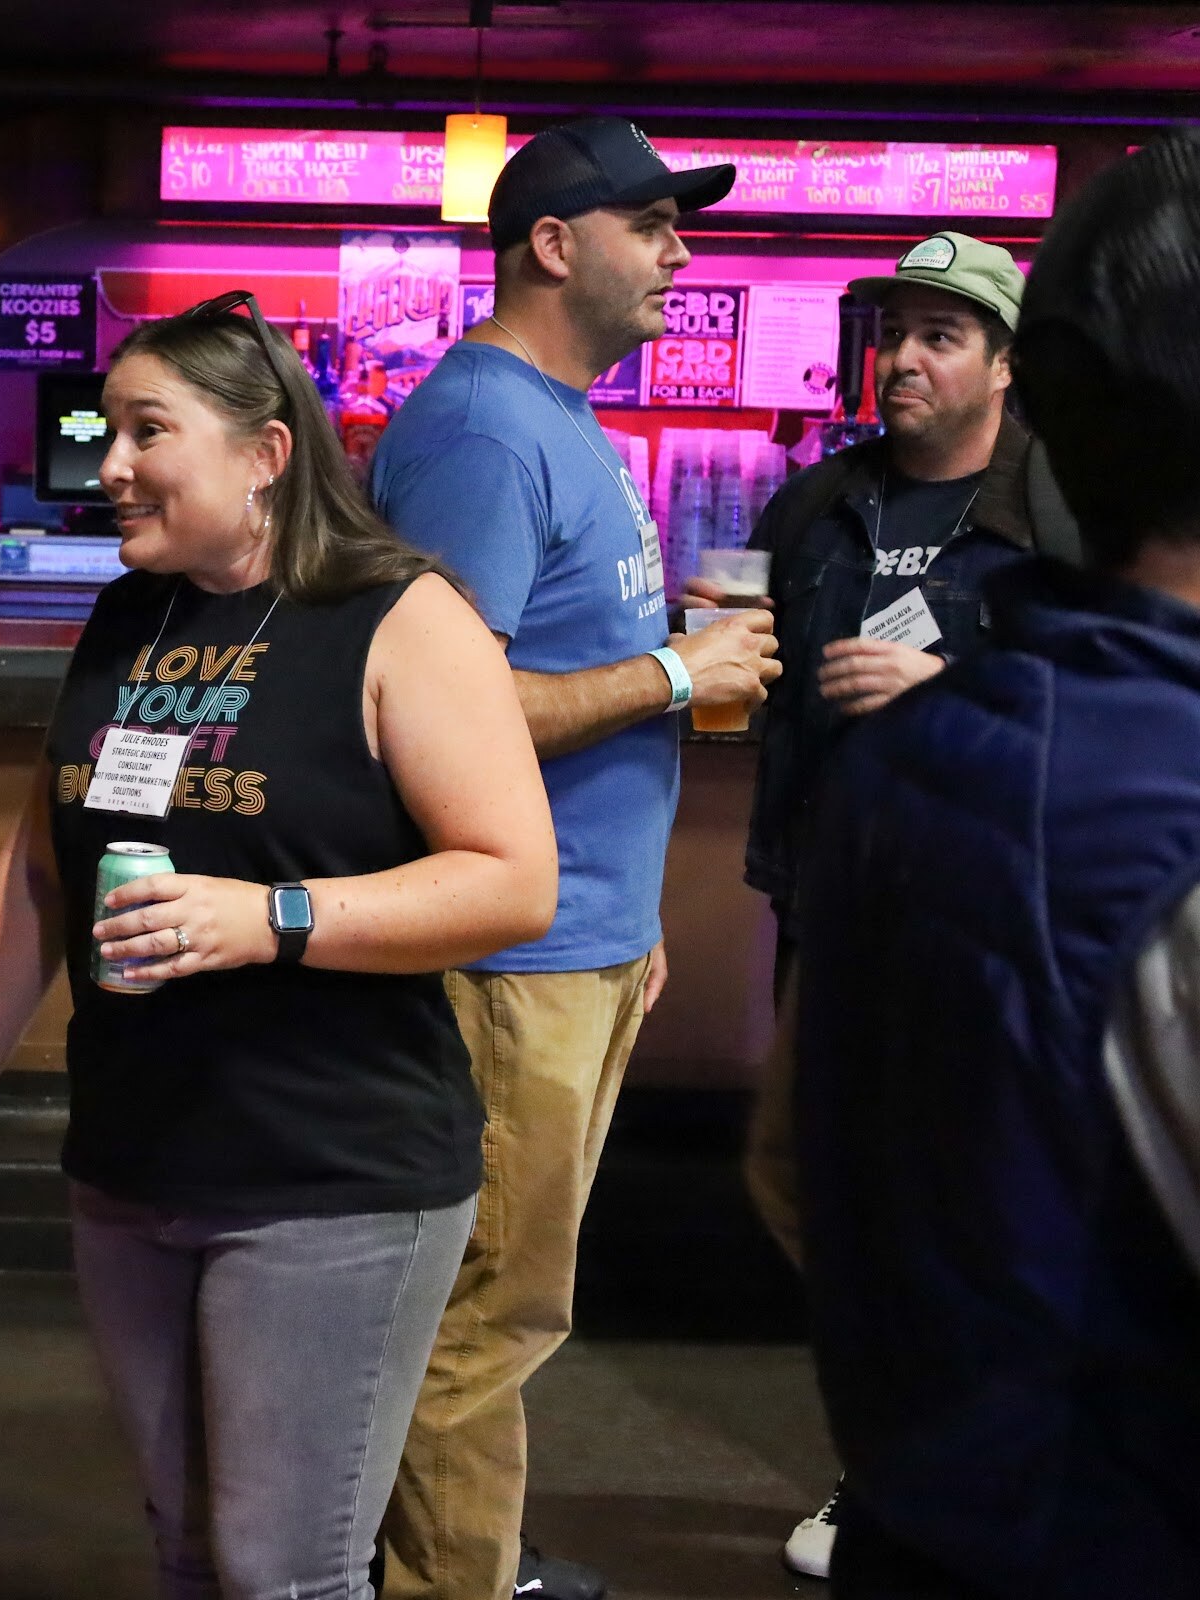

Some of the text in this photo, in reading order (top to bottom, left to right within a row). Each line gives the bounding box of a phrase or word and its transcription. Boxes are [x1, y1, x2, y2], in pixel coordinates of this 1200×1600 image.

[243, 160, 360, 178] THICK HAZE
[402, 166, 444, 185] DEN
[753, 168, 798, 184] LIGHT
[949, 166, 1005, 182] STELLA
[243, 179, 351, 199] ODELL IPA
[912, 177, 943, 209] $7
[949, 194, 1010, 211] MODELO
[1, 299, 80, 315] KOOZIES
[662, 291, 735, 316] CBD
[25, 320, 57, 345] $5
[665, 314, 734, 334] MULE
[657, 339, 732, 365] CBD
[655, 362, 731, 382] MARG
[652, 386, 678, 397] FOR
[868, 605, 912, 636] TOBIN VILLALVA
[901, 608, 926, 627] EXECUTIVE
[128, 642, 270, 683] LOVE
[112, 684, 250, 723] YOUR
[89, 724, 238, 763] CFT
[120, 734, 170, 747] JULIE RHODES
[112, 747, 167, 761] STRATEGIC BUSINESS
[118, 760, 152, 772] CONSULTANT
[104, 772, 118, 781] YOUR
[119, 774, 138, 783] HOBBY
[138, 776, 172, 788] MARKETING
[112, 786, 142, 798] SOLUTIONS
